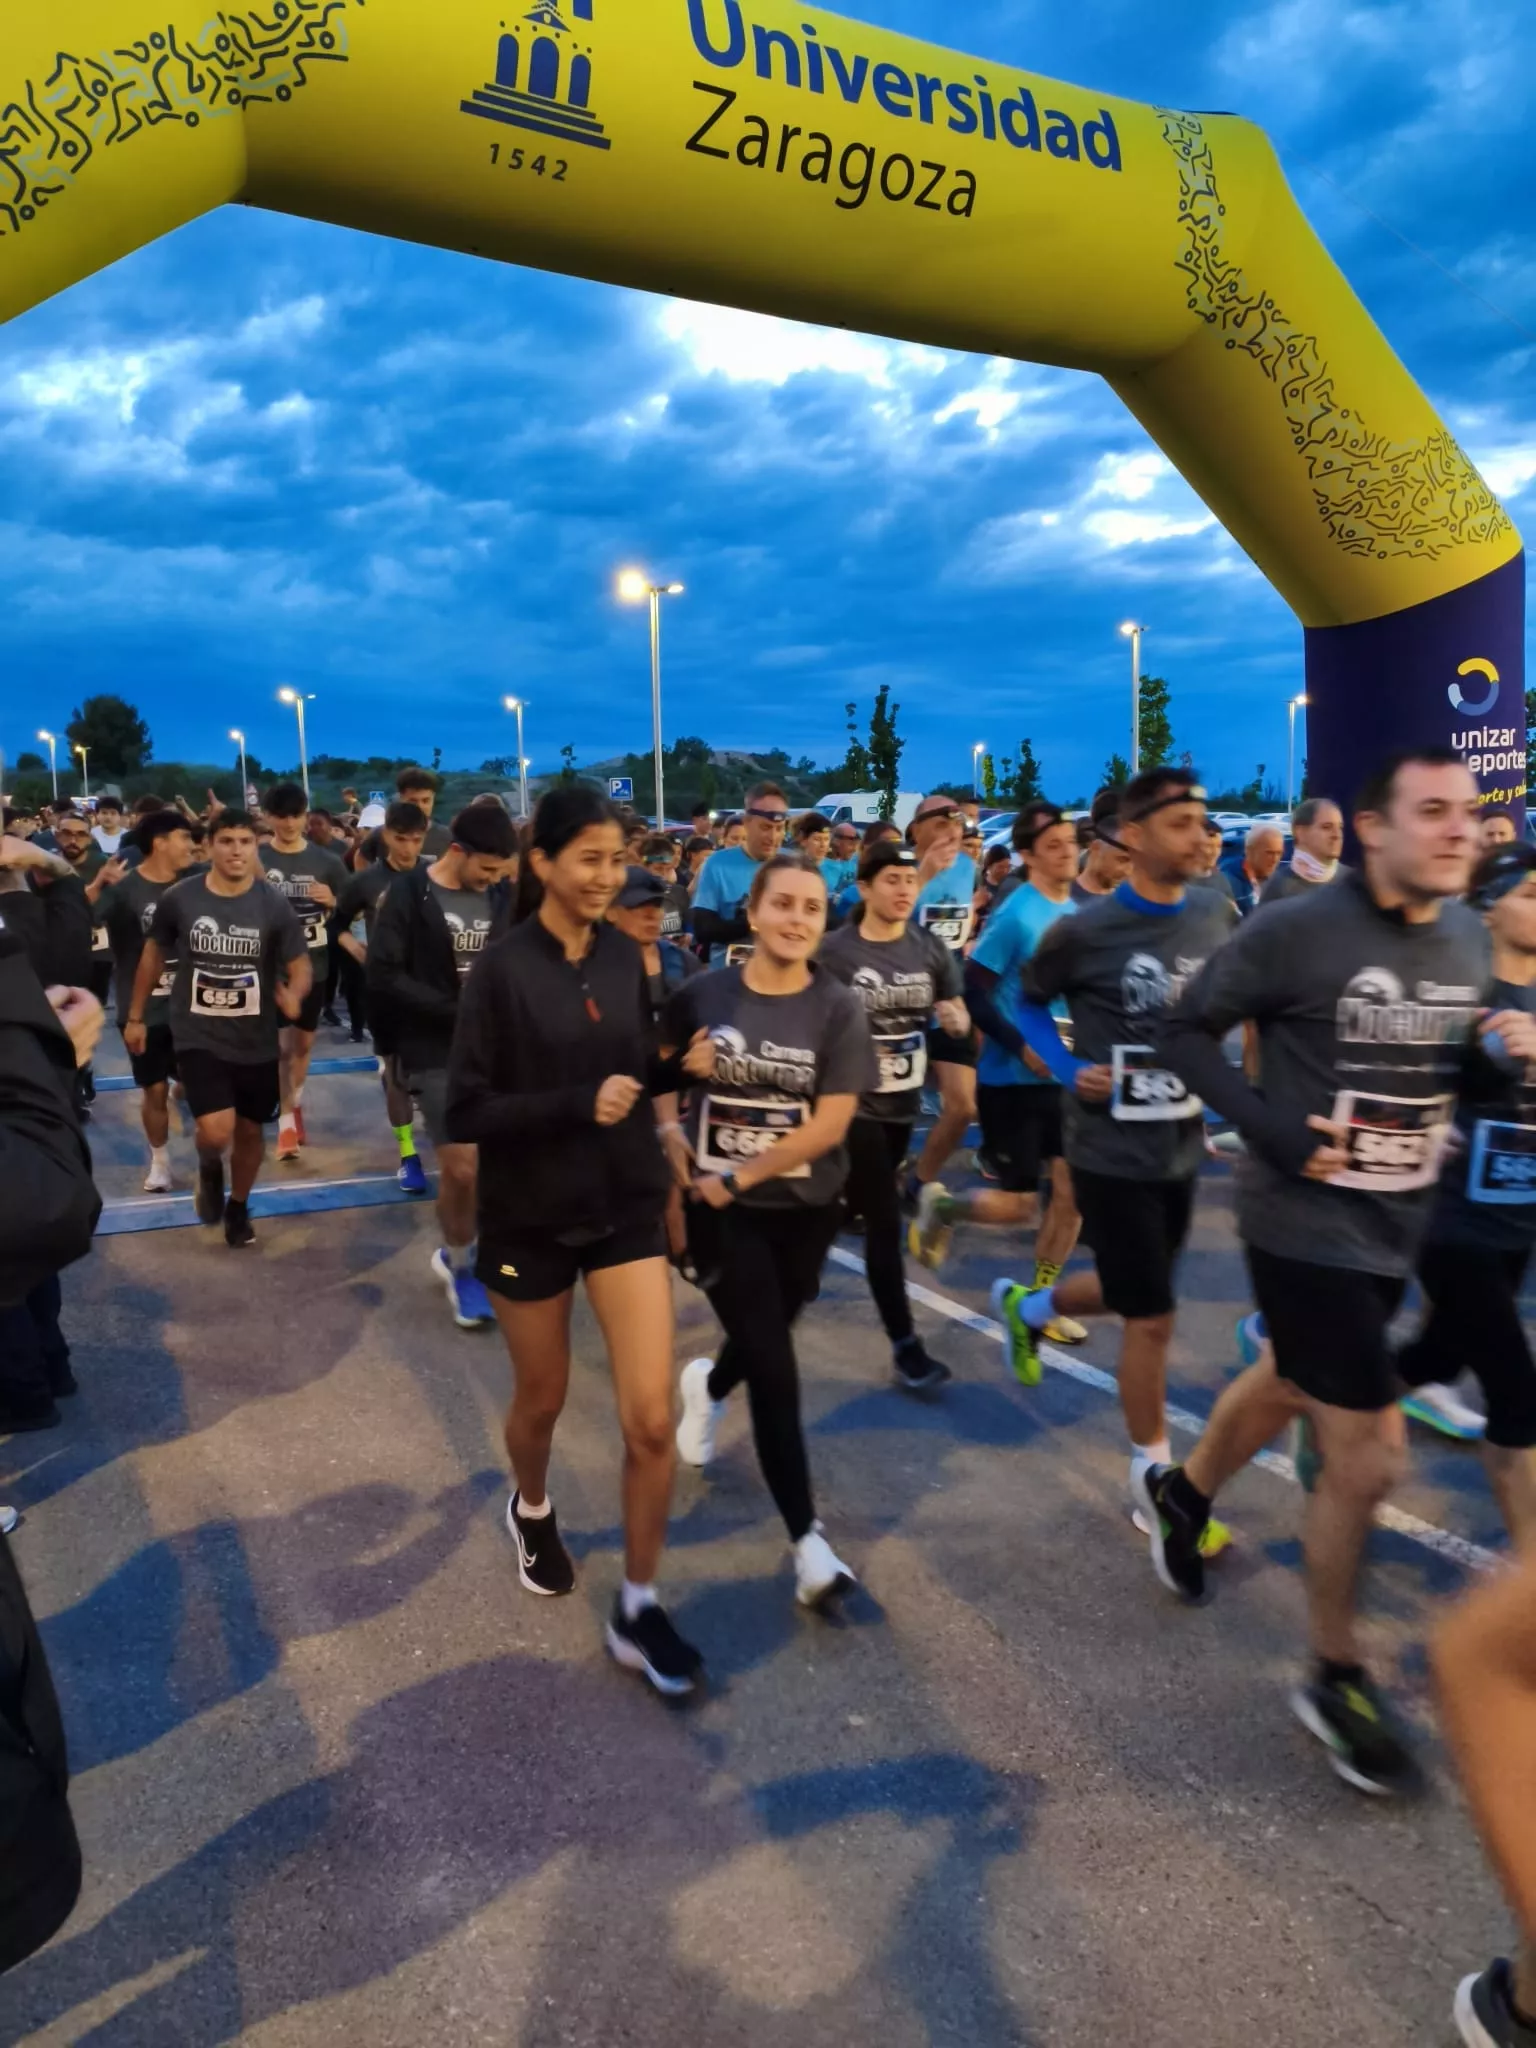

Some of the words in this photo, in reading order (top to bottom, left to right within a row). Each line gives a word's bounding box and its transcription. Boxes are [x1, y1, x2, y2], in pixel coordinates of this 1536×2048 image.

[686, 0, 1122, 171] Universidad
[490, 143, 568, 181] 1542
[685, 80, 977, 218] Zaragoza
[1451, 725, 1516, 750] unizar
[612, 780, 622, 793] P
[189, 929, 261, 957] Nocturna
[202, 989, 239, 1005] 655
